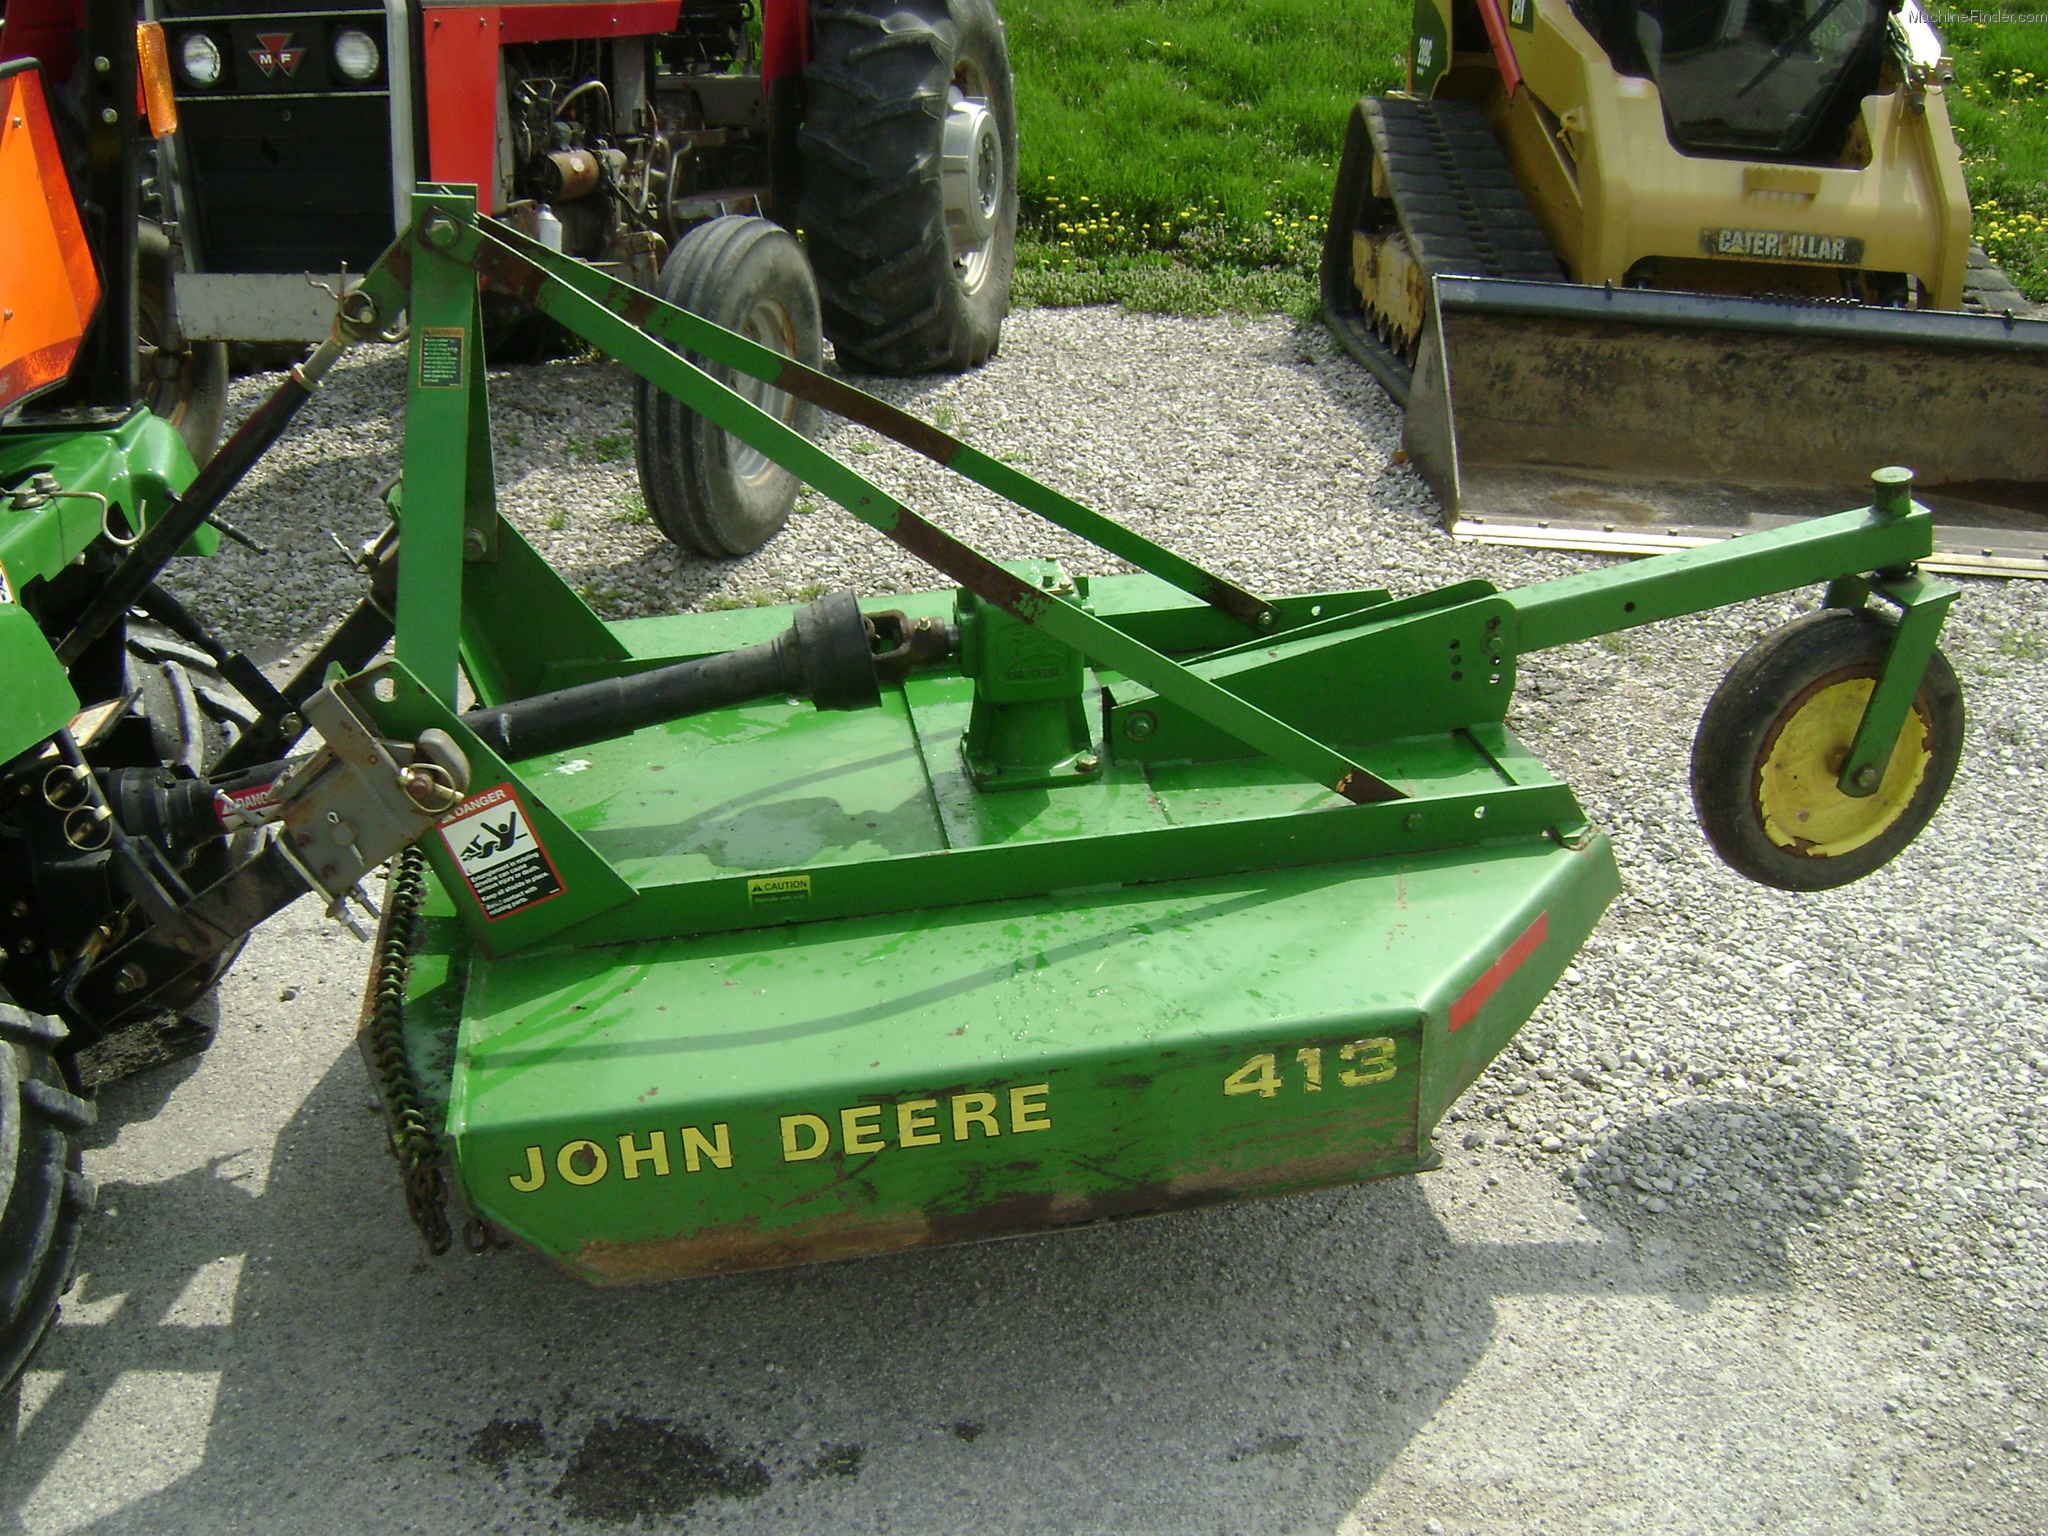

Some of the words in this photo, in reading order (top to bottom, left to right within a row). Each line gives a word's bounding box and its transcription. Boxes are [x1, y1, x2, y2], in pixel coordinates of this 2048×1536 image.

[455, 789, 507, 817] DANGER
[470, 863, 510, 883] Entanglement
[516, 852, 540, 864] rotating
[473, 875, 499, 889] driveline
[510, 863, 528, 874] cause
[477, 882, 499, 894] serious
[498, 876, 515, 885] injury
[481, 893, 498, 902] Keep
[497, 888, 505, 896] all
[505, 881, 526, 893] shields
[531, 872, 550, 882] place.
[502, 891, 525, 903] contact
[525, 886, 538, 894] with
[764, 880, 807, 891] CAUTION
[489, 903, 512, 916] rotating
[511, 897, 528, 907] parts.
[1223, 1036, 1397, 1099] 413
[508, 1122, 734, 1193] JOHN
[778, 1082, 1052, 1163] DEERE
